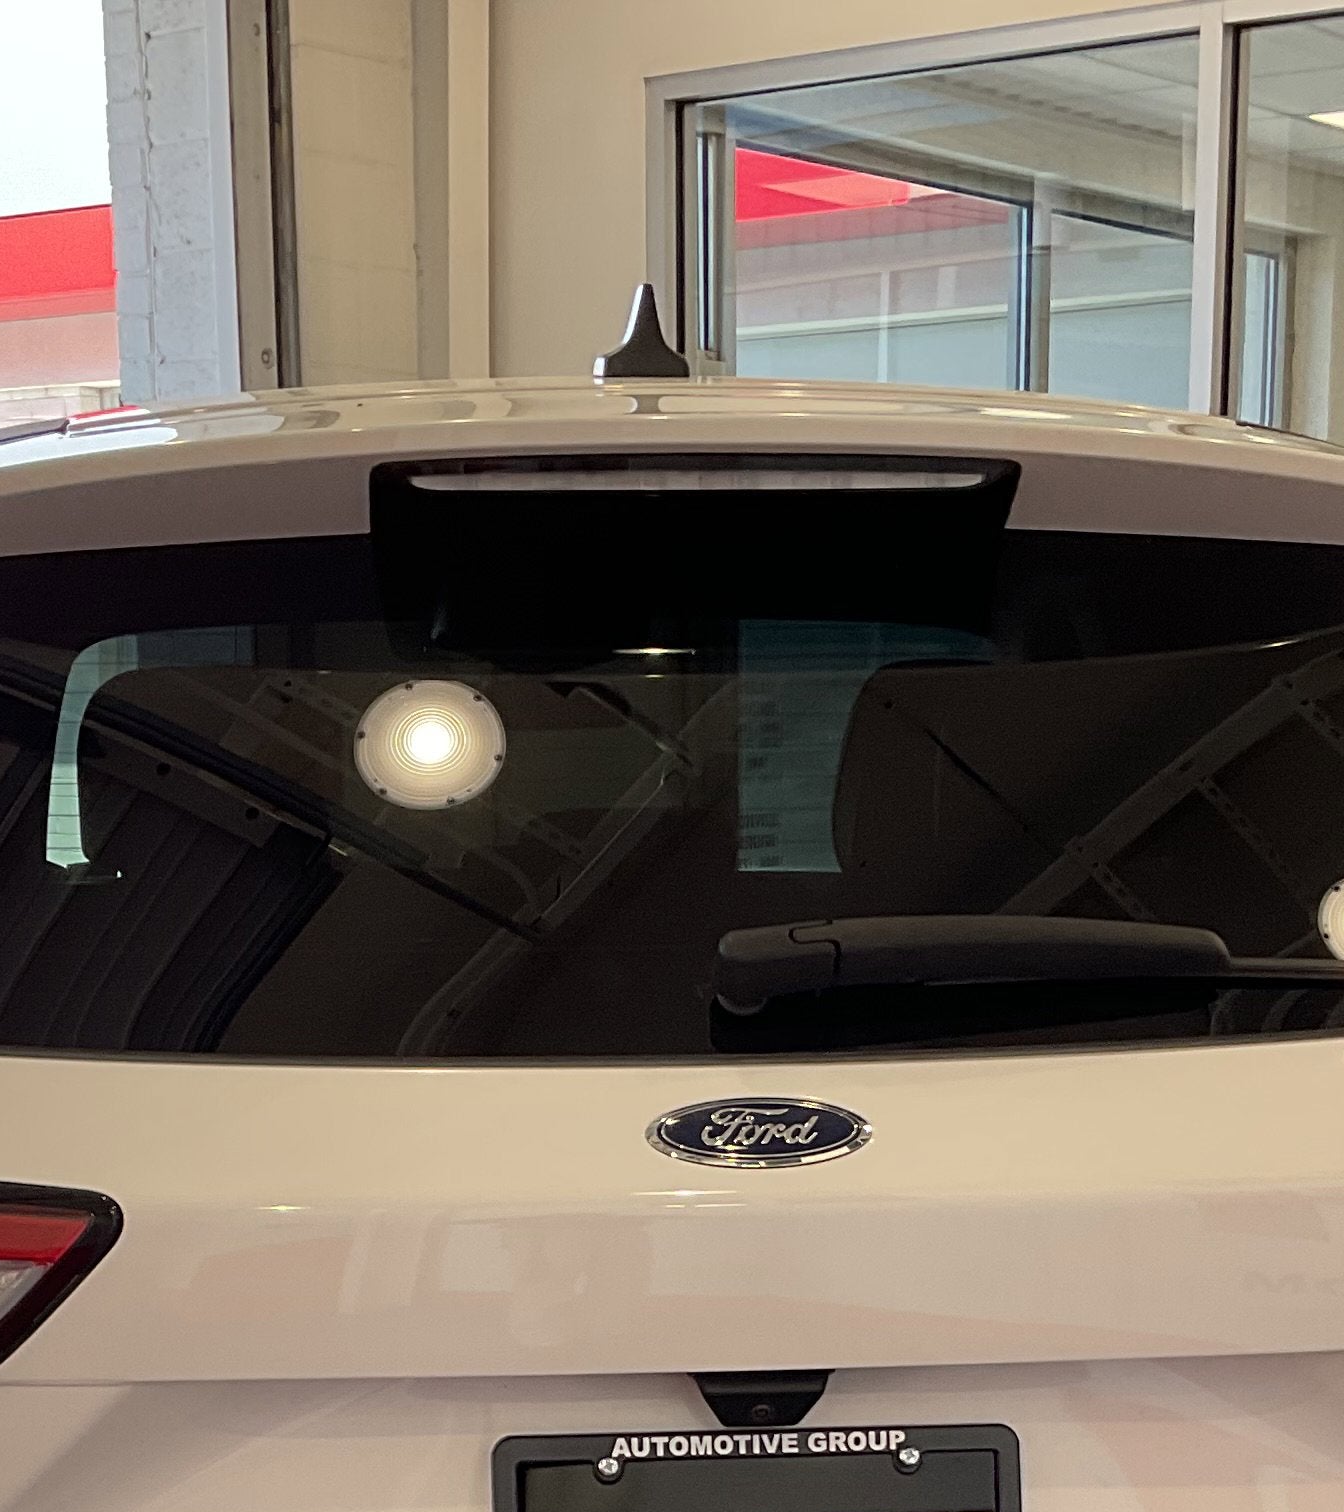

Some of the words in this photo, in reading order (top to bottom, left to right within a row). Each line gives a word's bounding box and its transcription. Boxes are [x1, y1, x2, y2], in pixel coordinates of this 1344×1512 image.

[700, 1107, 819, 1151] Ford
[612, 1432, 799, 1459] AUTOMOTIVE
[807, 1429, 907, 1453] GROUP
